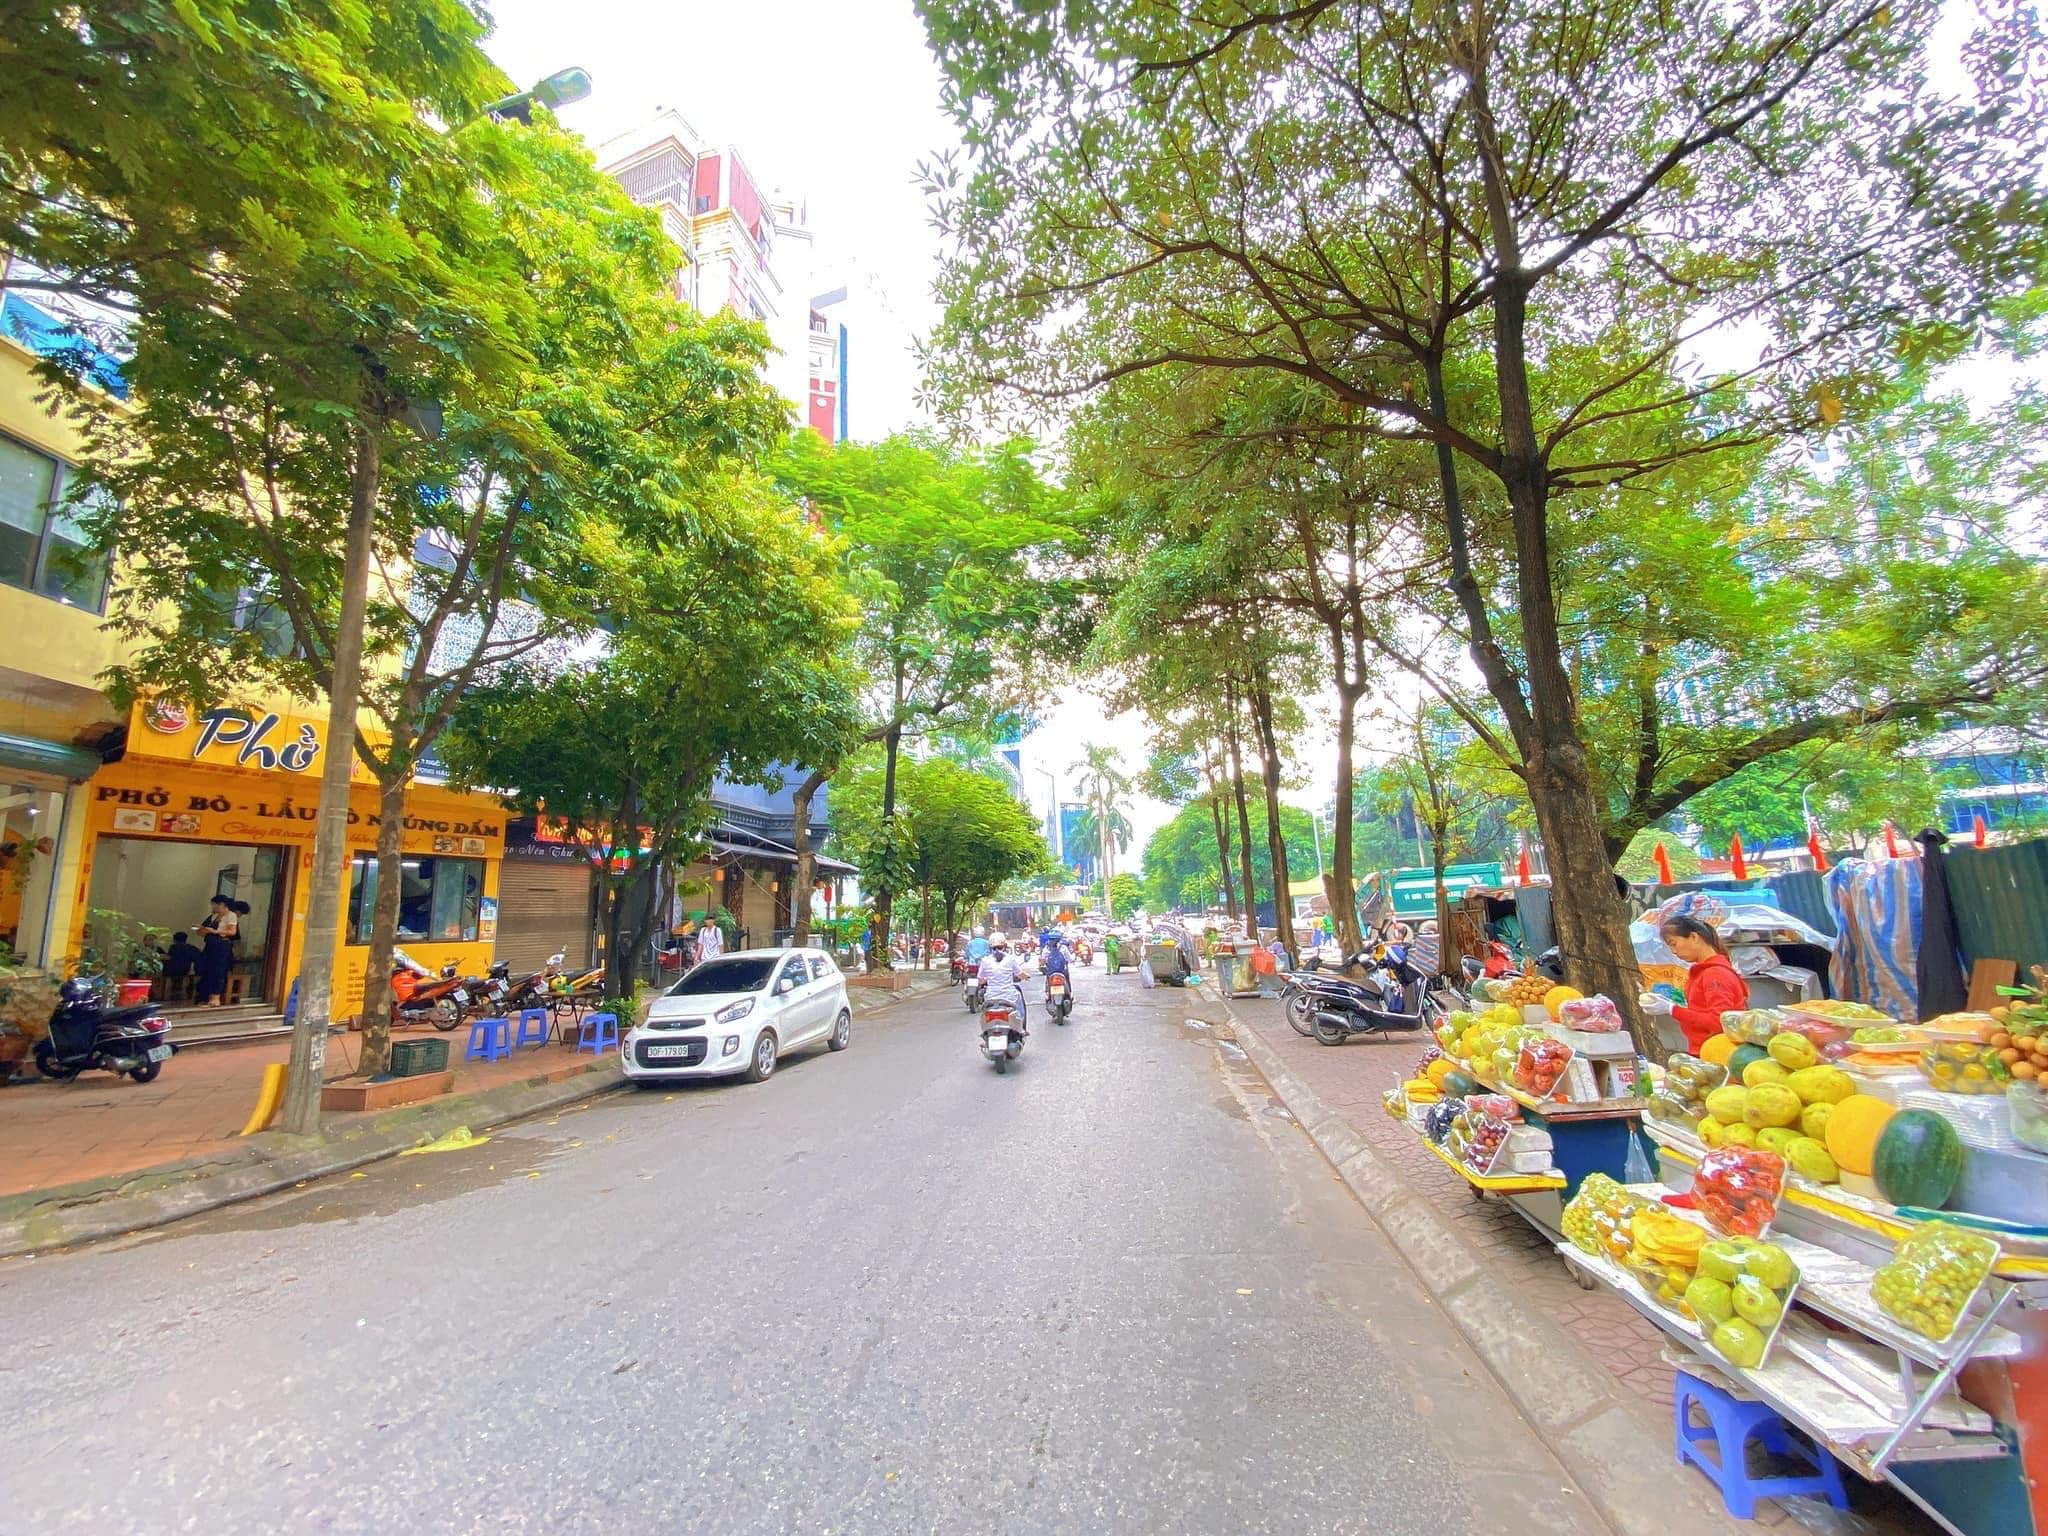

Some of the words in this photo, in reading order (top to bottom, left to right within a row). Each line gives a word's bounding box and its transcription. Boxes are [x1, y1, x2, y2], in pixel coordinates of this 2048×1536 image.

[194, 708, 320, 771] Phở
[97, 786, 170, 807] PHỞ
[189, 795, 230, 813] BÒ
[367, 813, 449, 833] NÚNG
[453, 818, 499, 838] DẤM
